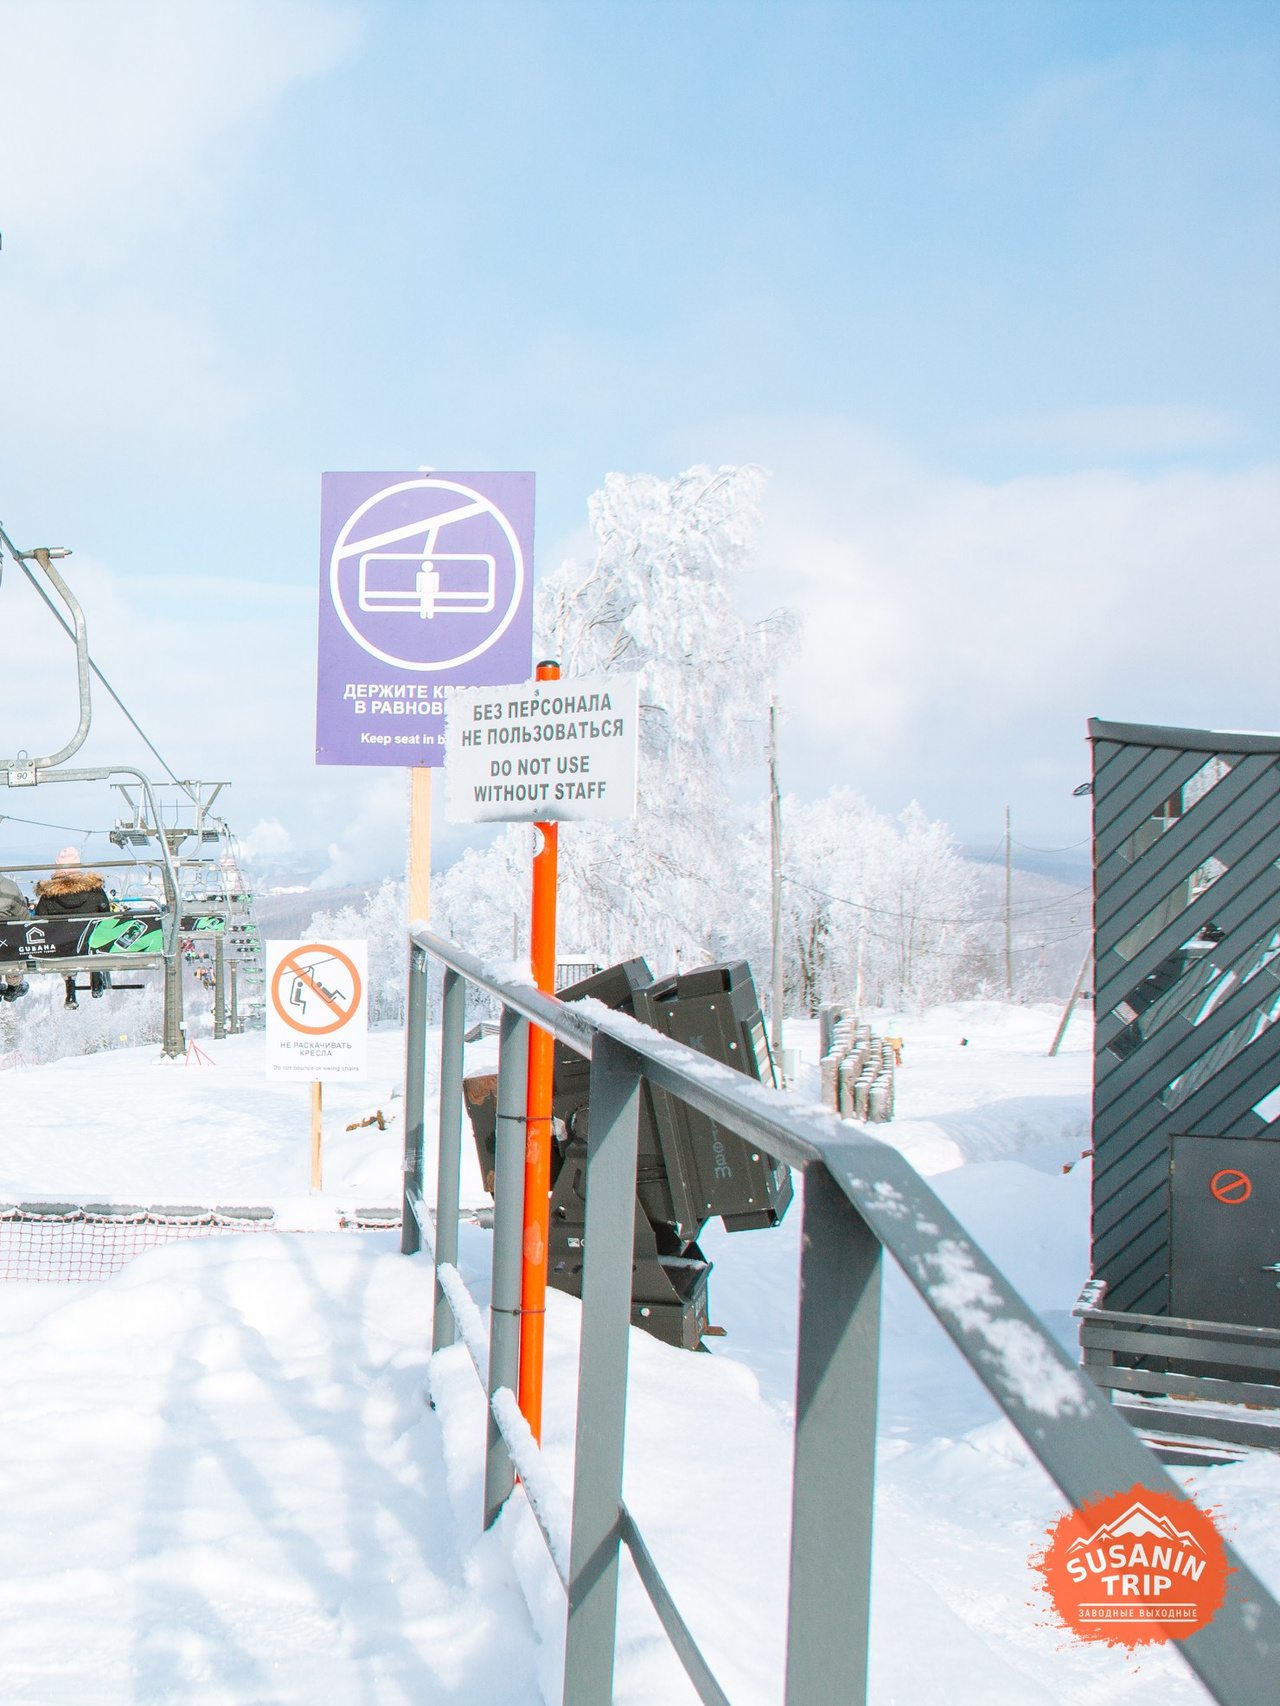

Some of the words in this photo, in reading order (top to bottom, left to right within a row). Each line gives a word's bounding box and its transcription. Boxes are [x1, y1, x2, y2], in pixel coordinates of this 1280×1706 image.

[343, 684, 428, 700] ДЕРЖИТЕ
[354, 700, 367, 714] В
[371, 701, 444, 715] РАВНОВ
[473, 703, 503, 721] БЕЗ
[508, 693, 612, 719] ПЕРСОНАЛА
[361, 733, 392, 746] Keep
[394, 734, 421, 745] seat
[423, 734, 434, 744] in
[462, 730, 482, 747] НЕ
[487, 719, 624, 745] ПОЛЬЗОВАТЬСЯ
[490, 760, 512, 777] DO
[518, 757, 551, 776] NOT
[557, 756, 590, 774] USE
[473, 783, 549, 802] WITHOUT
[555, 781, 607, 800] STAFF
